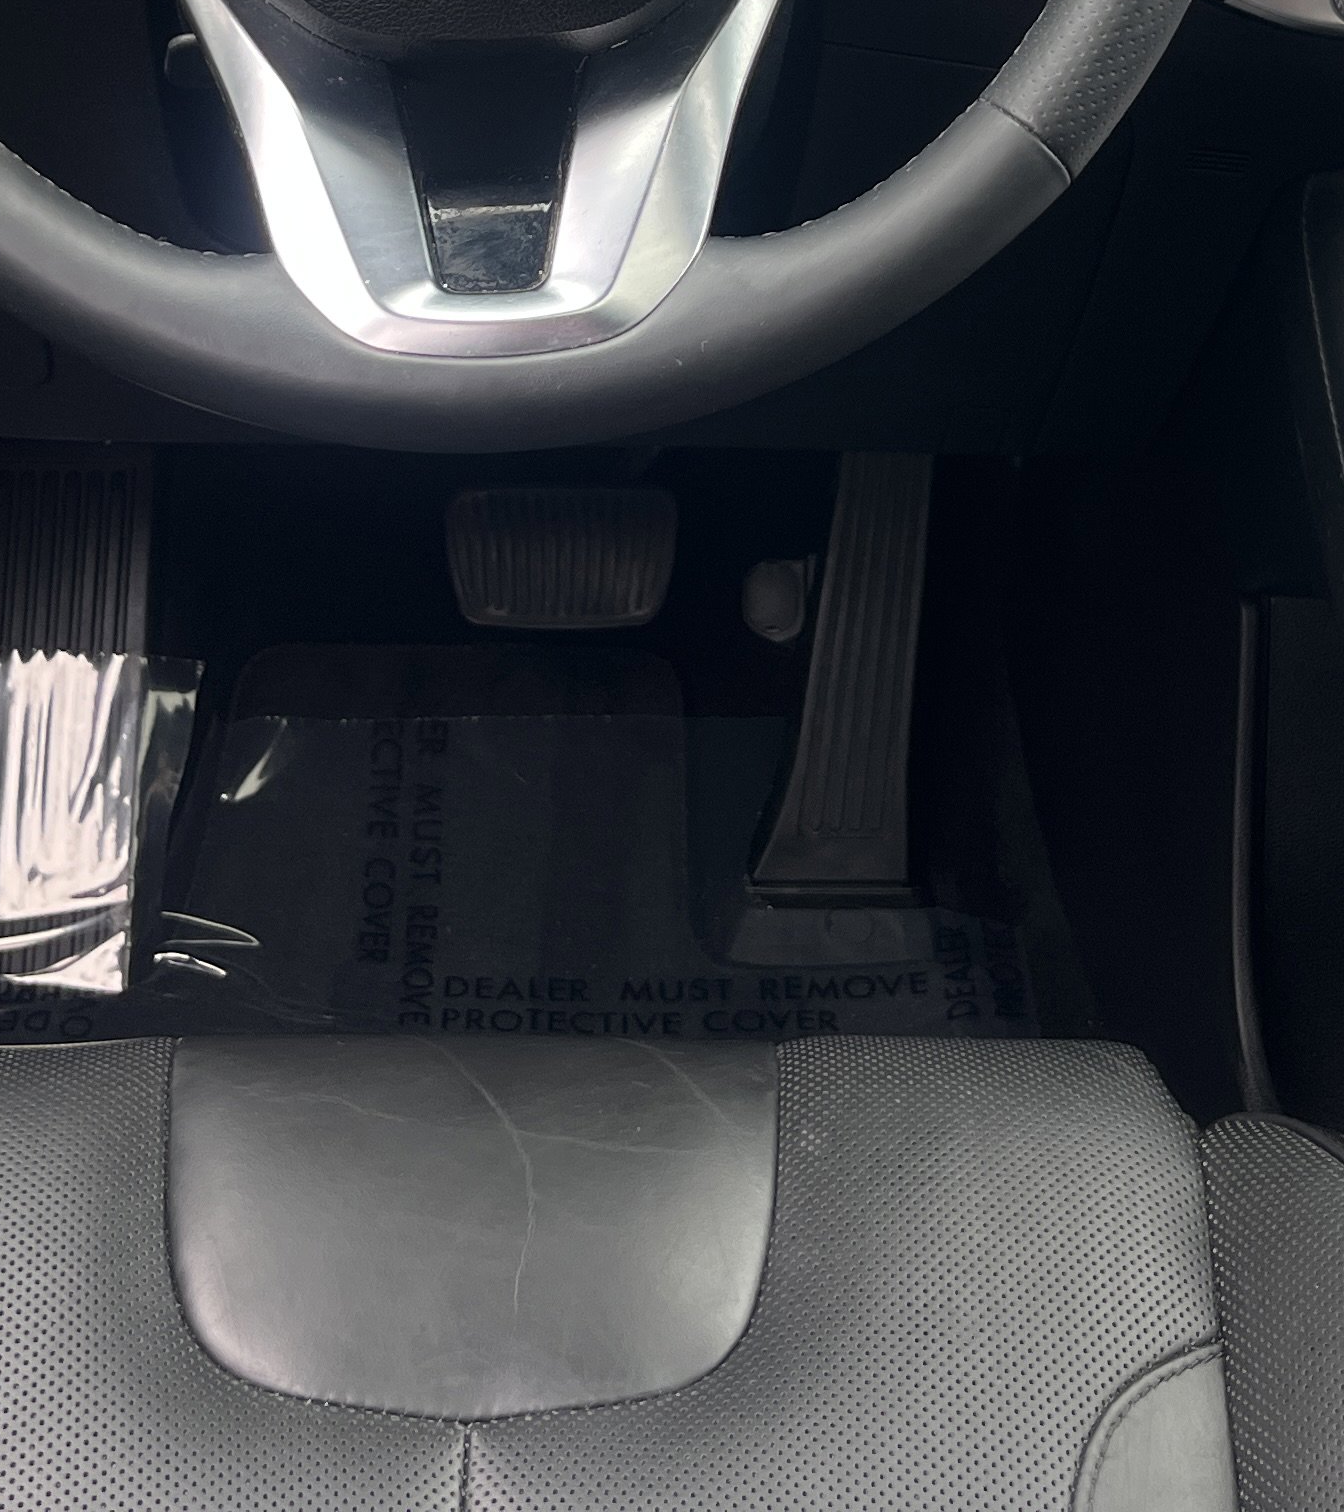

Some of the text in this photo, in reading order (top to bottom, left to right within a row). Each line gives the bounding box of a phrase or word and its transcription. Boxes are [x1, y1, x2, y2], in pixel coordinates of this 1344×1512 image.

[442, 971, 931, 1004] DEALER MUST REMOVE
[440, 1007, 840, 1035] PROTECTIVE COVER
